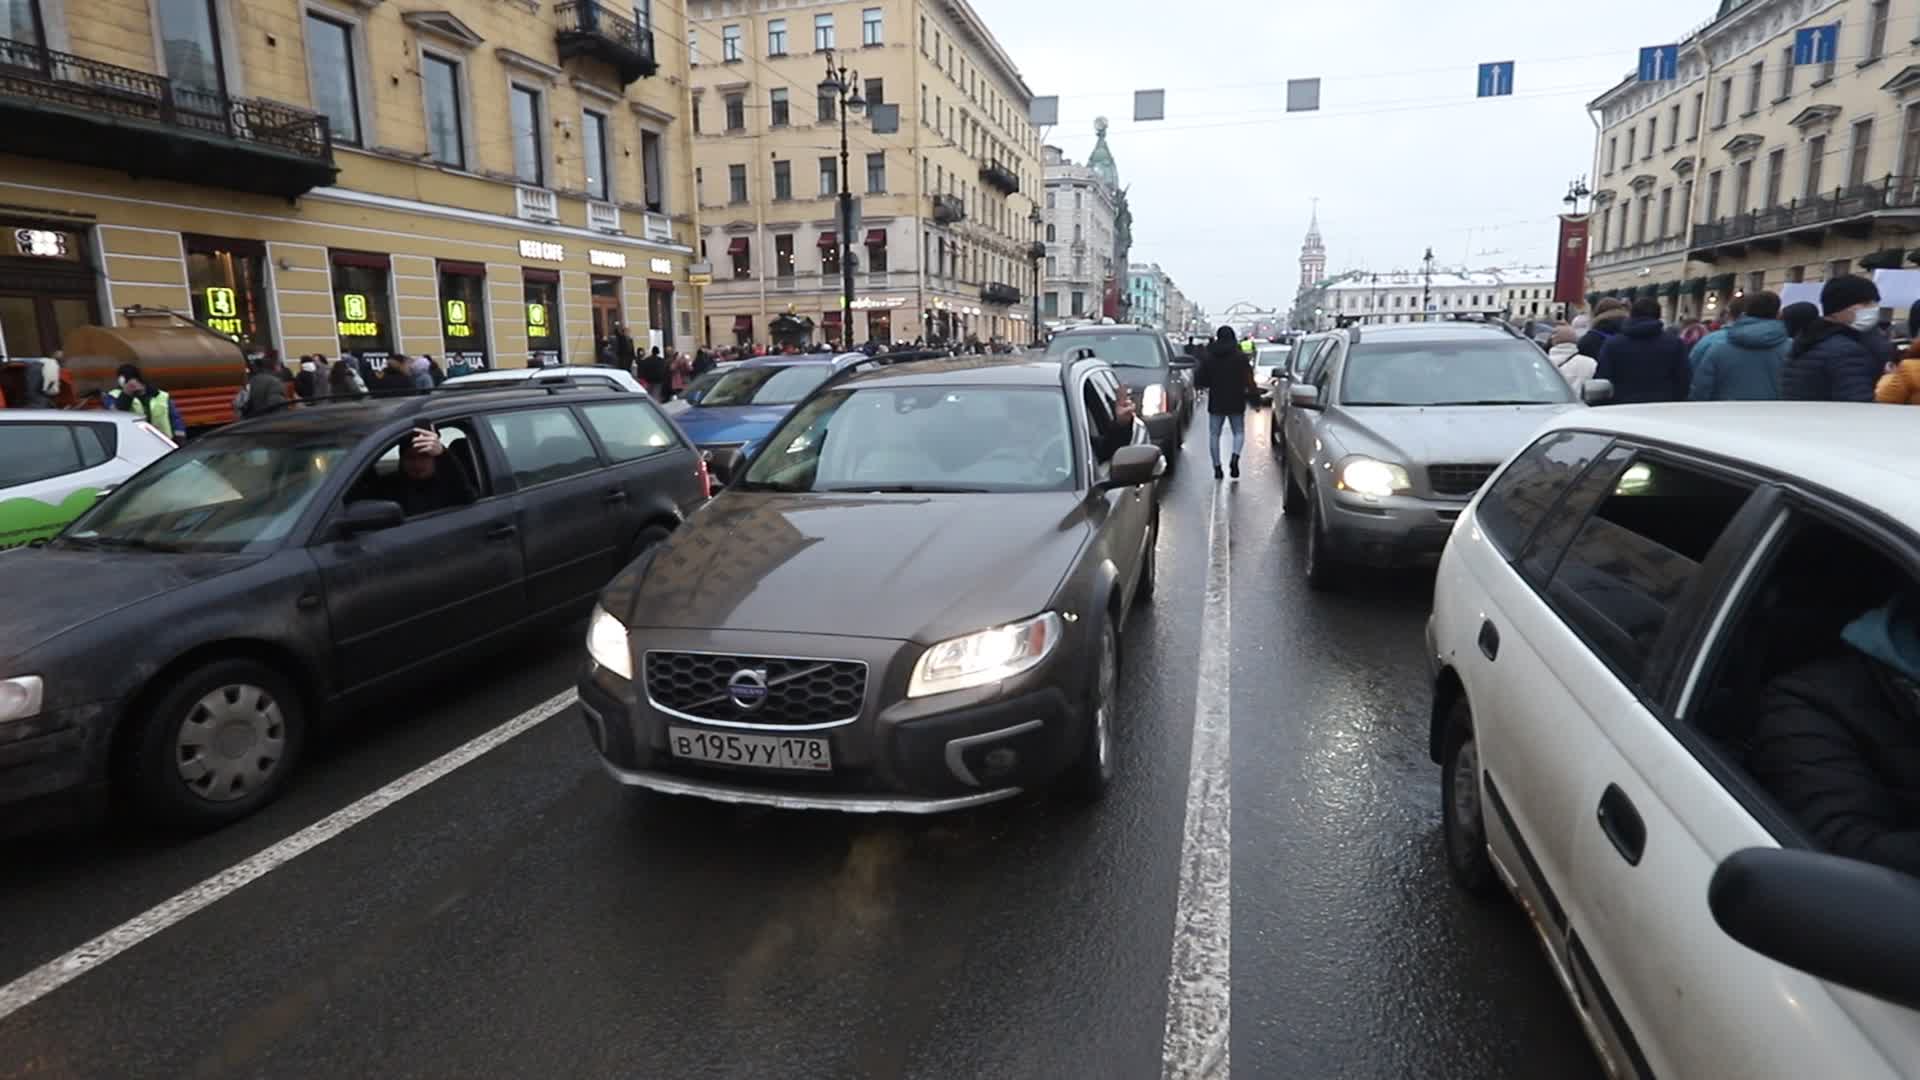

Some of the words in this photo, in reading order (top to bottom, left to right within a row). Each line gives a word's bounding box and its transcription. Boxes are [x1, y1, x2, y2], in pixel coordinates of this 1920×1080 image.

[338, 322, 377, 336] BURGERS
[448, 325, 470, 337] PIZZA
[782, 739, 822, 760] 178
